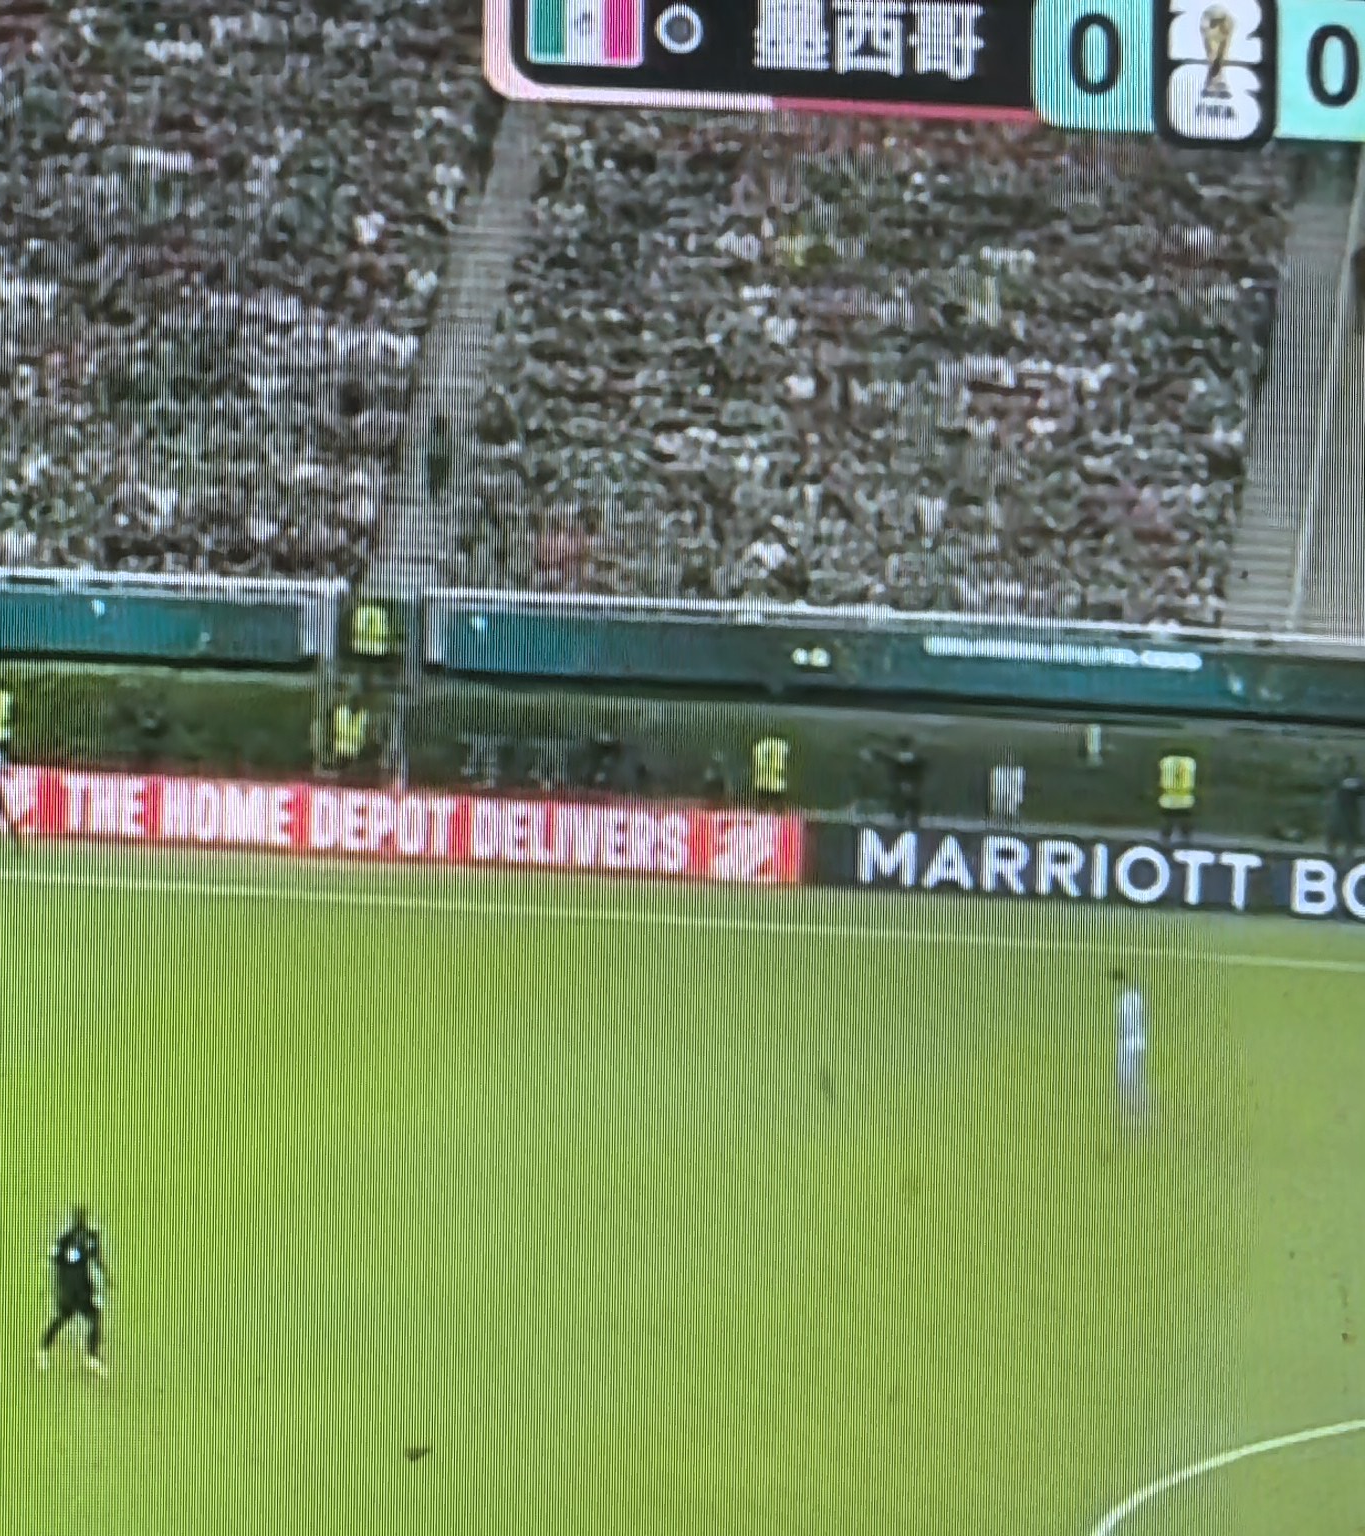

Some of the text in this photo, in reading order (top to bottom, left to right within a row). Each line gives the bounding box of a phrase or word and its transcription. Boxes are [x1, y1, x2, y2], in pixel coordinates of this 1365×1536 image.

[754, 0, 985, 80] 墨西哥
[1070, 13, 1121, 95] 0
[1307, 24, 1359, 107] 0
[65, 772, 145, 836] THE
[162, 777, 294, 846] HOME
[311, 787, 457, 857] DEPOT
[471, 797, 690, 874] DELIVERS
[857, 826, 1262, 912] MARRIOTT
